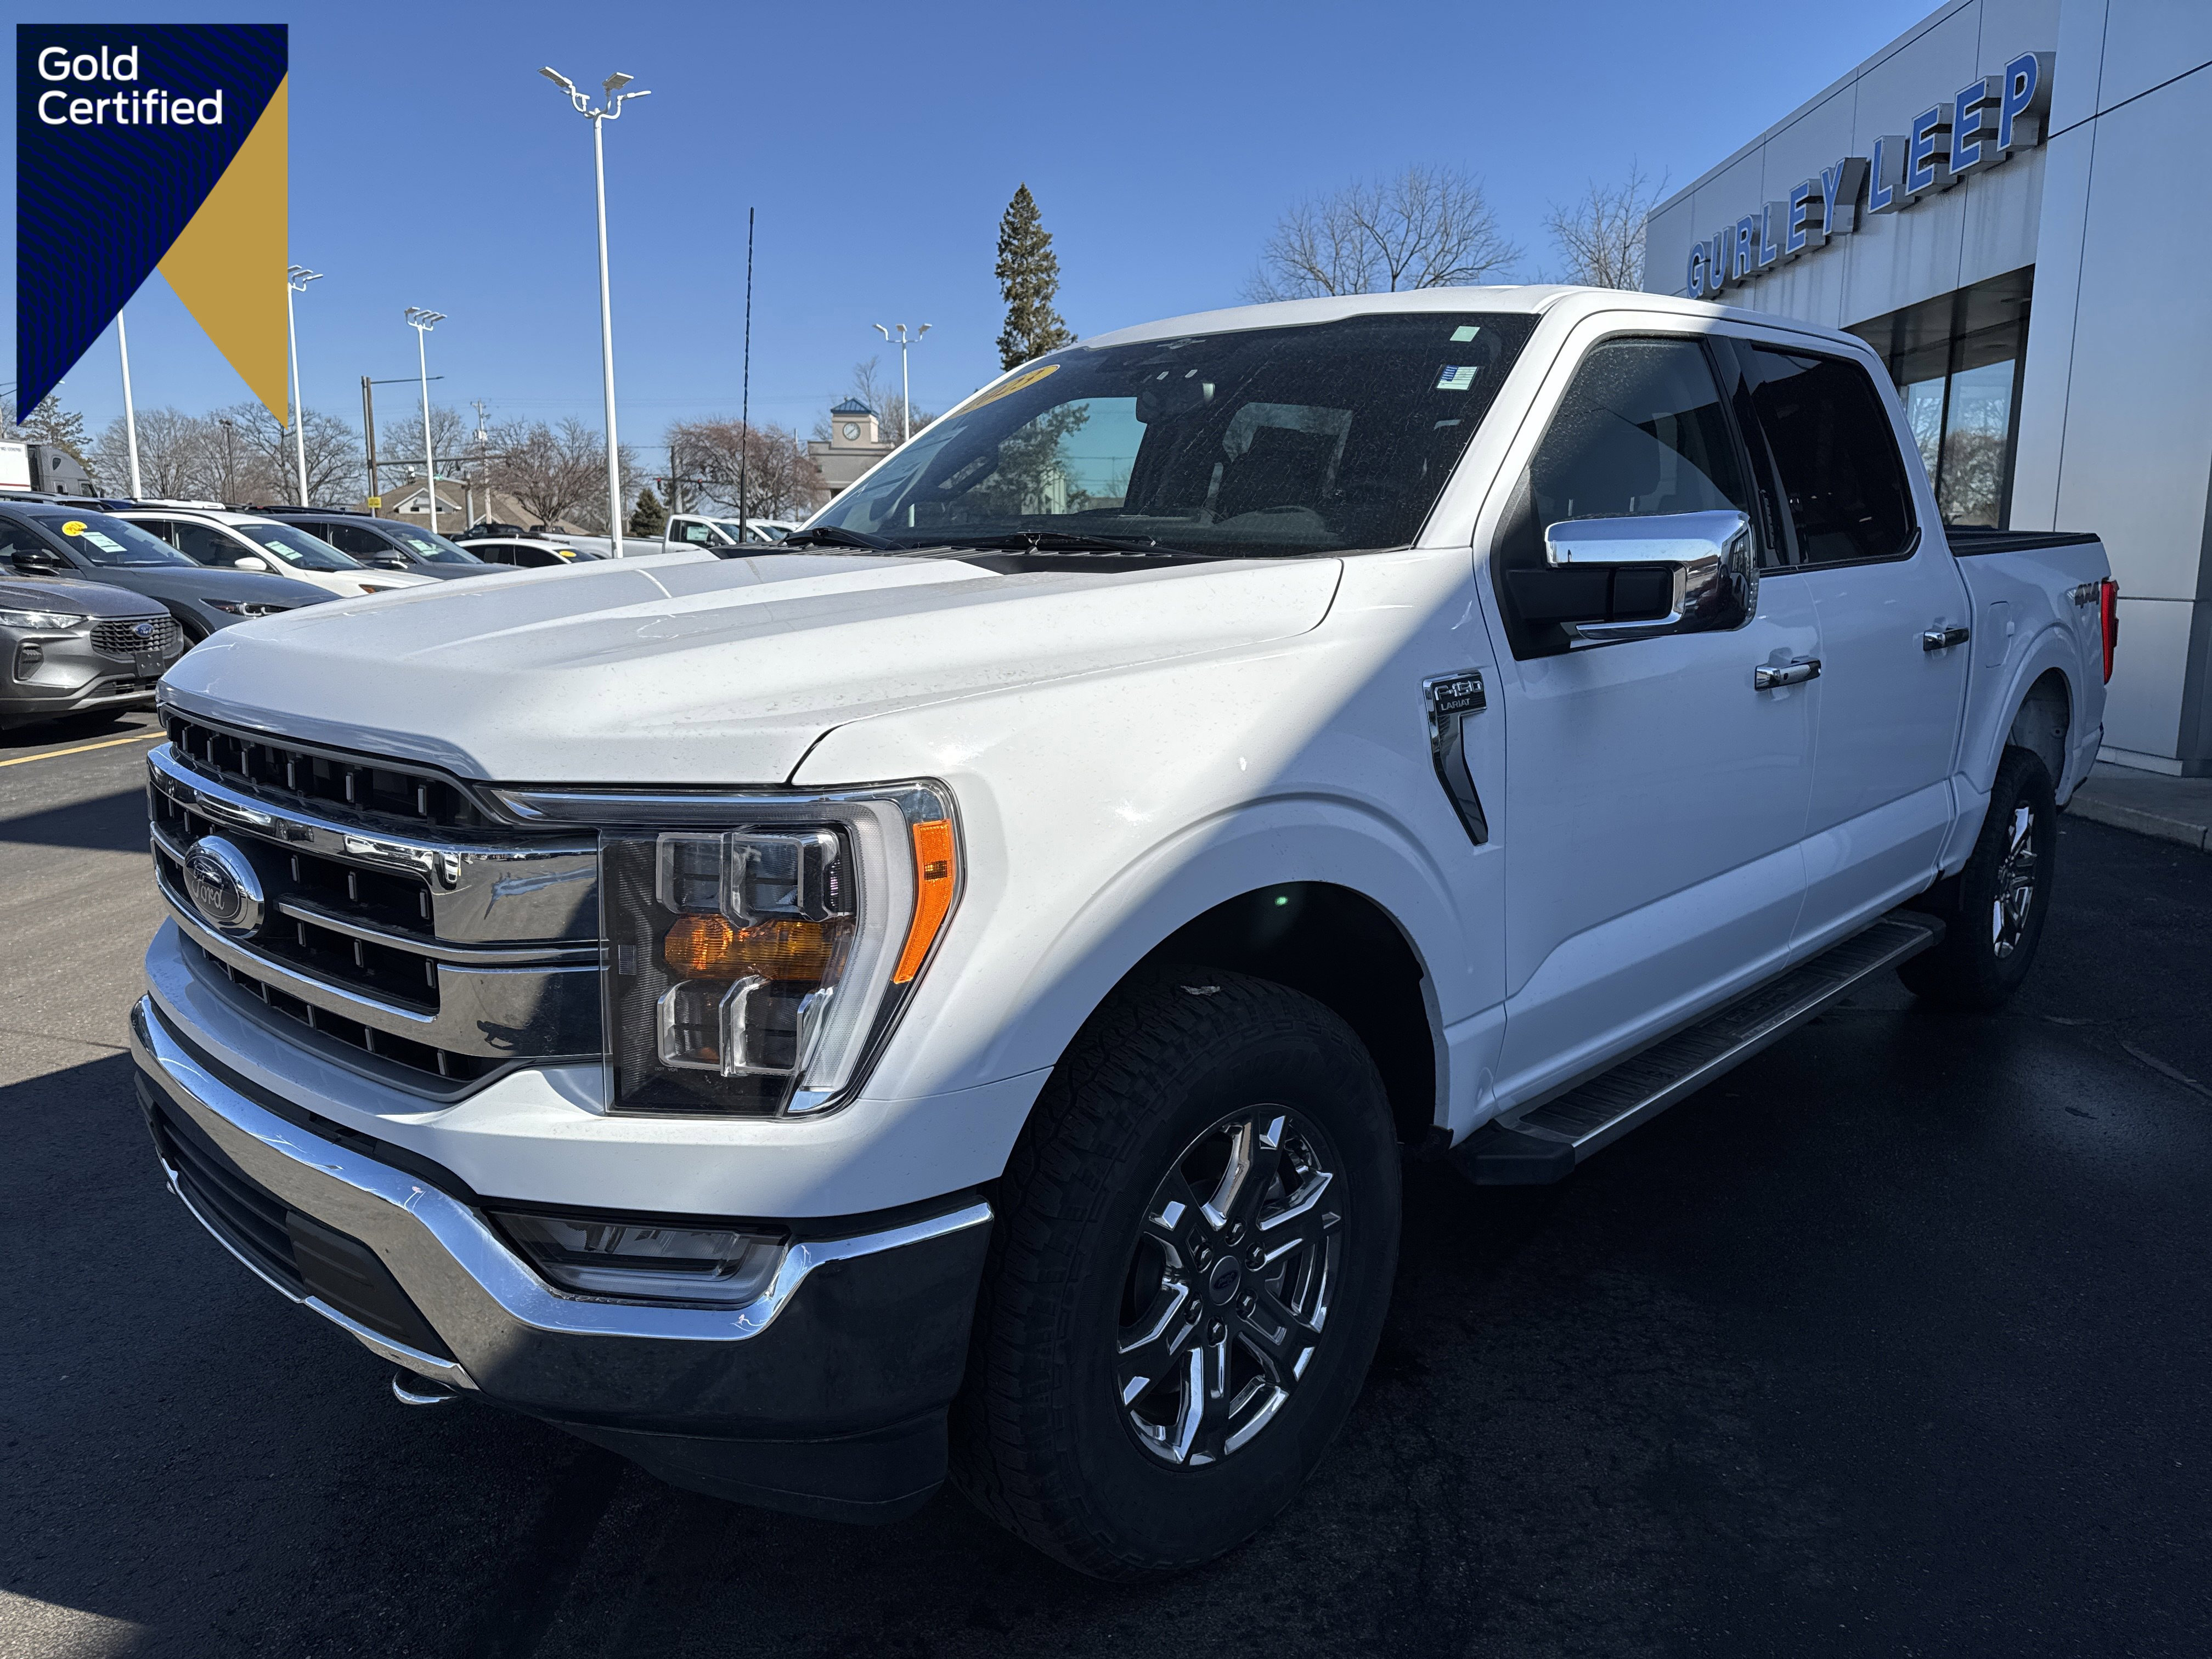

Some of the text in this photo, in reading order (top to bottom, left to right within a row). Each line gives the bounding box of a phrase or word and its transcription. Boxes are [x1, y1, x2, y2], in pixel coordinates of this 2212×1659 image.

[1686, 51, 2039, 299] GURLEY LEEP
[1434, 680, 1482, 701] F-150
[1441, 698, 1470, 711] LARIAT
[191, 860, 225, 910] Ford
